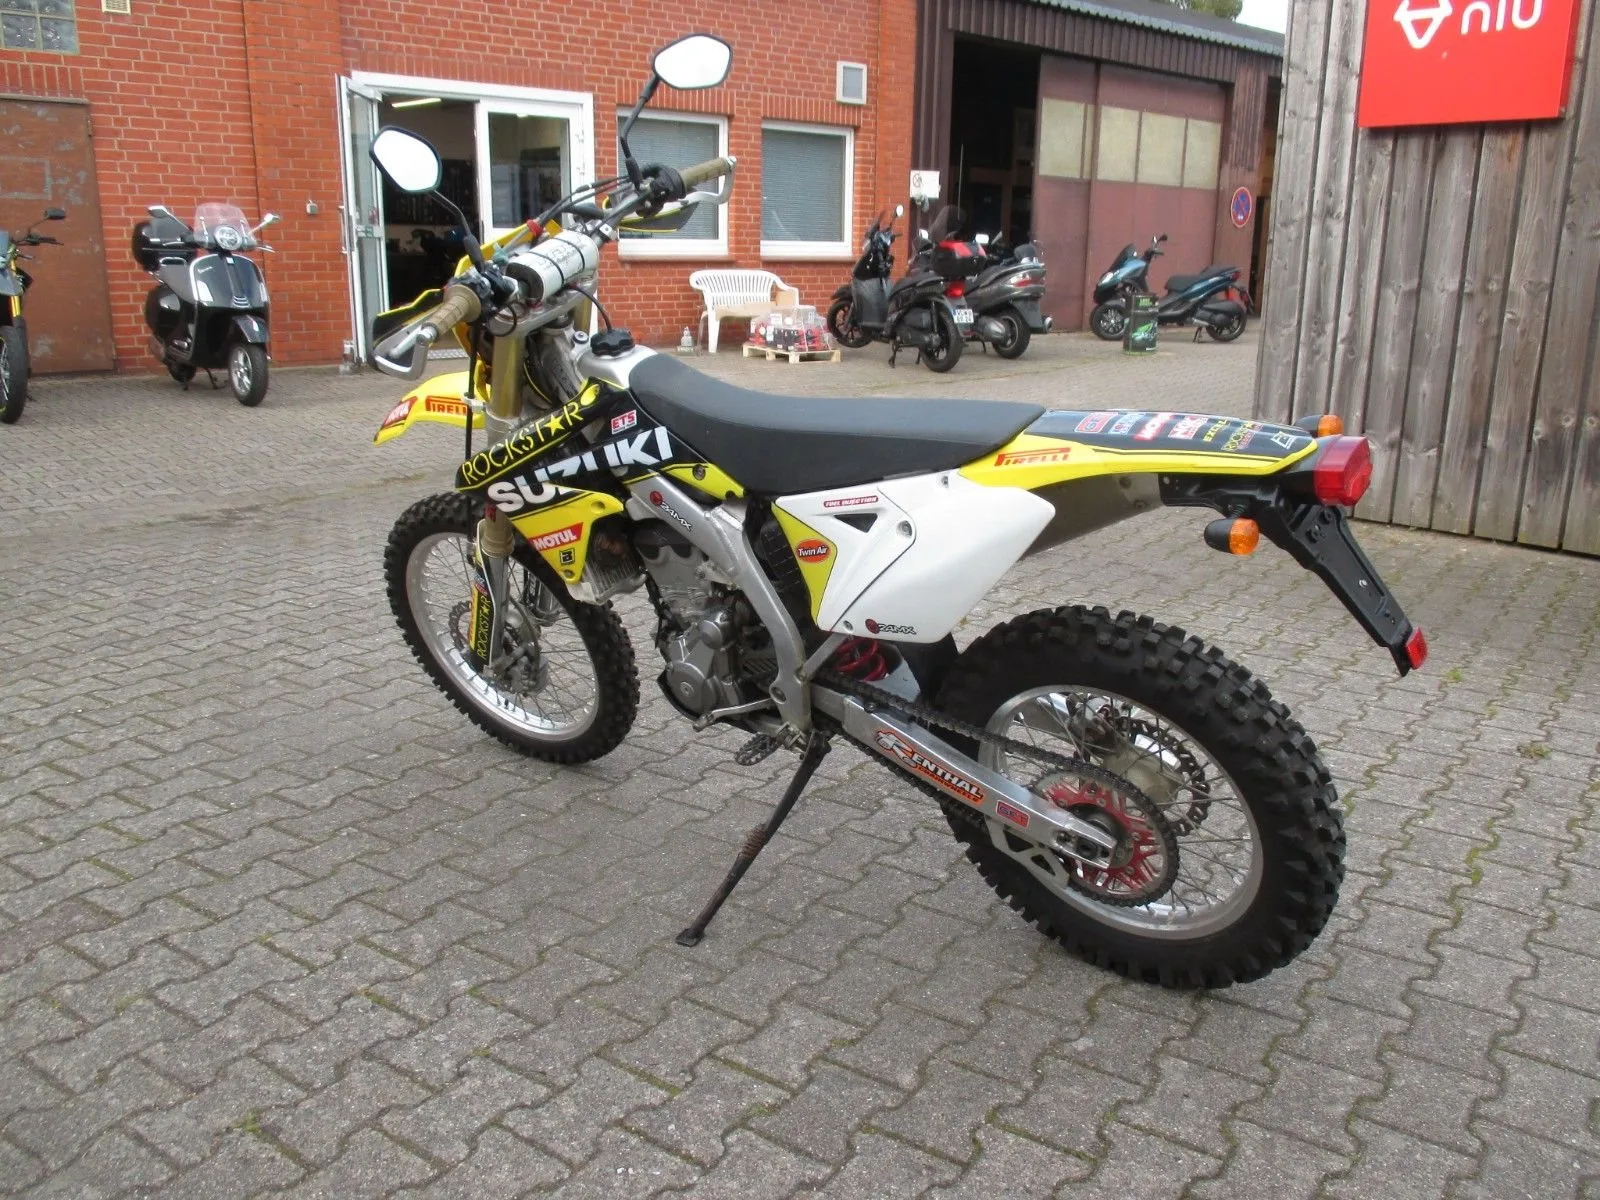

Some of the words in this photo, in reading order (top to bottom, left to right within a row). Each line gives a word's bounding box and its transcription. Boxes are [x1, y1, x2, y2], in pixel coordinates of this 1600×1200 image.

[612, 411, 635, 430] ETS
[994, 447, 1071, 467] PIRELLI
[487, 426, 673, 512] SUZUKI
[842, 496, 877, 506] INJECTION
[532, 528, 577, 551] MOTUL
[798, 547, 816, 557] Twin
[816, 545, 828, 556] Air
